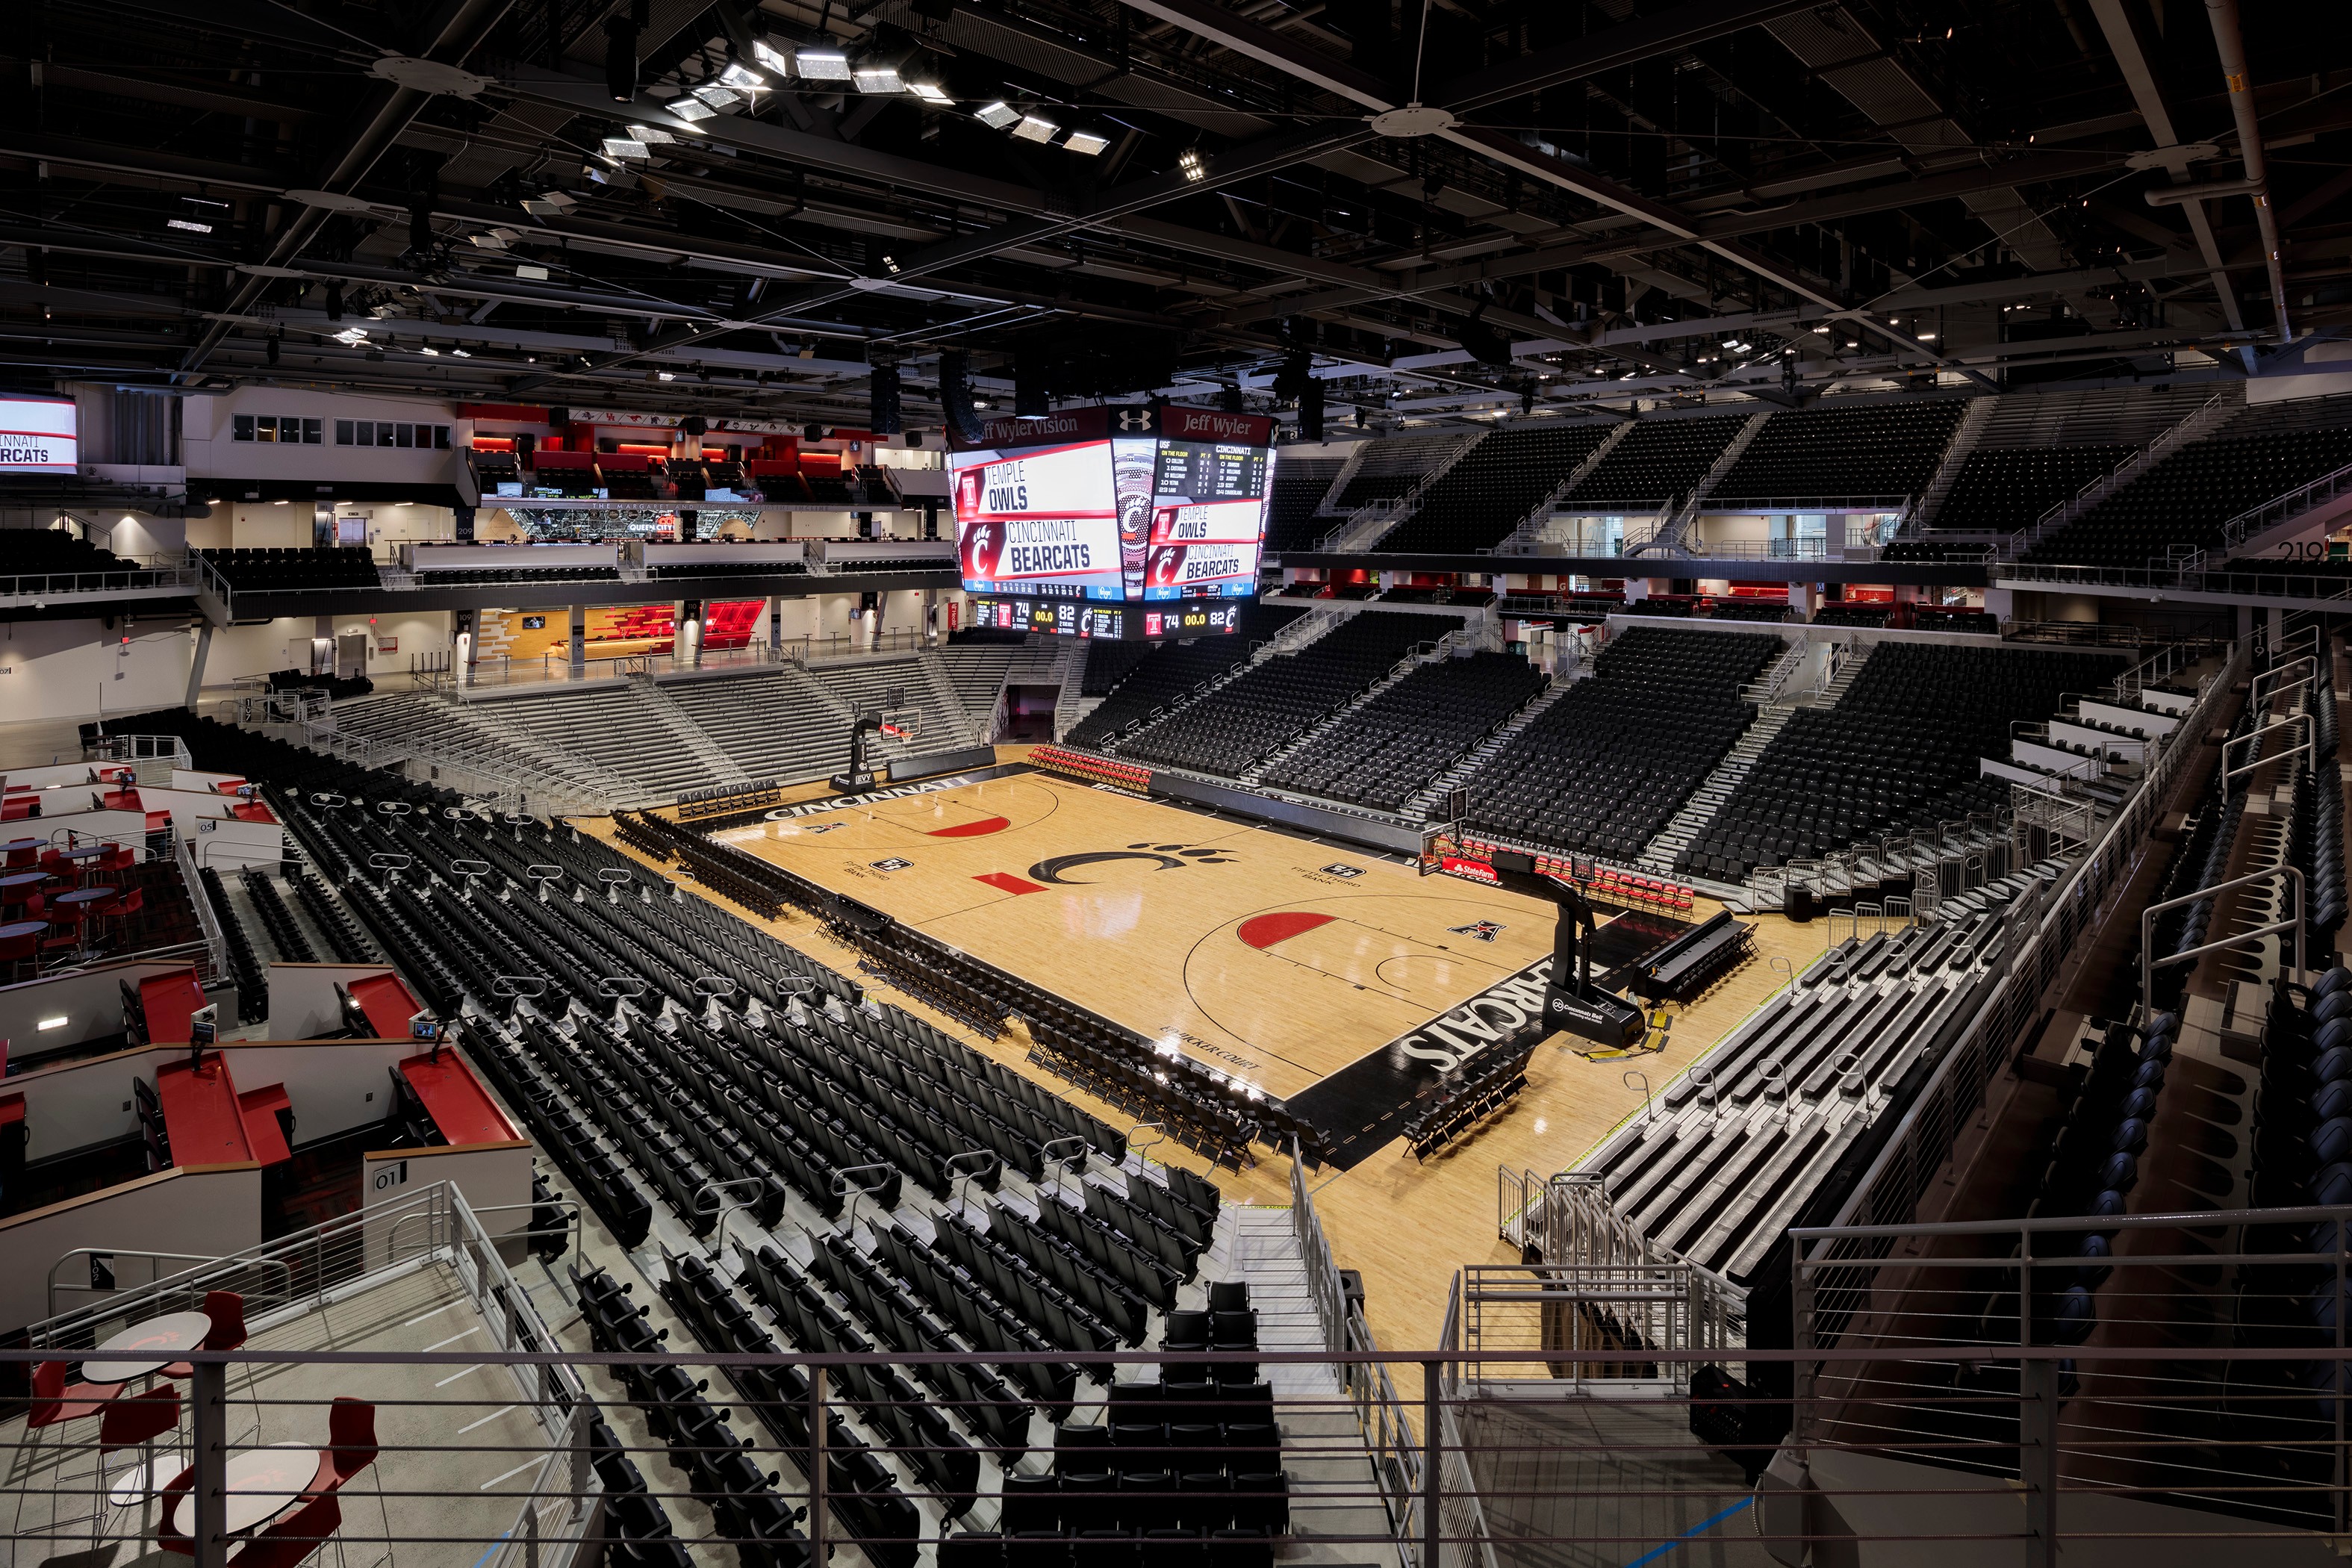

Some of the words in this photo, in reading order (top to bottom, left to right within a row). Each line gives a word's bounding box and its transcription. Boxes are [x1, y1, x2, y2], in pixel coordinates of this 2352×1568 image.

[983, 423, 995, 439] ff
[1183, 414, 1210, 432] Jeff
[1213, 417, 1251, 438] Wyler
[0, 435, 39, 448] INNATI
[1159, 441, 1171, 449] USF
[0, 449, 49, 462] RCATS
[1216, 445, 1251, 455] CINCINNATI
[986, 461, 1025, 486] TEMPLE
[989, 485, 1028, 511] OWLS
[1180, 506, 1209, 521] TEMPLE
[1008, 520, 1077, 544] CINCINNATI
[1178, 522, 1207, 538] OWLS
[1010, 544, 1091, 573] BEARCATS
[1188, 545, 1233, 560] CINCINNATI
[2278, 541, 2324, 561] 219
[1186, 559, 1239, 579] BEARCATS
[1015, 602, 1030, 617] 74
[1035, 611, 1054, 622] 00.0
[1058, 605, 1074, 621] 82
[1165, 615, 1180, 629] 74
[1185, 615, 1206, 626] 00.0
[1210, 612, 1225, 626] 82
[1493, 623, 1504, 637] 115
[2254, 623, 2265, 658] 119
[856, 773, 871, 785] LEVY
[764, 777, 971, 821] CINCINNATI
[200, 824, 212, 832] 05
[843, 861, 866, 871] FIFTH
[865, 869, 890, 881] THIRD
[844, 868, 868, 879] BANK
[1291, 867, 1323, 878] FIFTH
[1327, 876, 1361, 888] THIRD
[1301, 874, 1334, 885] BANK
[1400, 955, 1611, 1072] BARCATS
[1564, 1004, 1591, 1017] Cincinnati
[1591, 1012, 1603, 1021] Bell
[1569, 1011, 1584, 1020] connecting
[1216, 1051, 1262, 1070] COURT
[376, 1172, 394, 1189] 01
